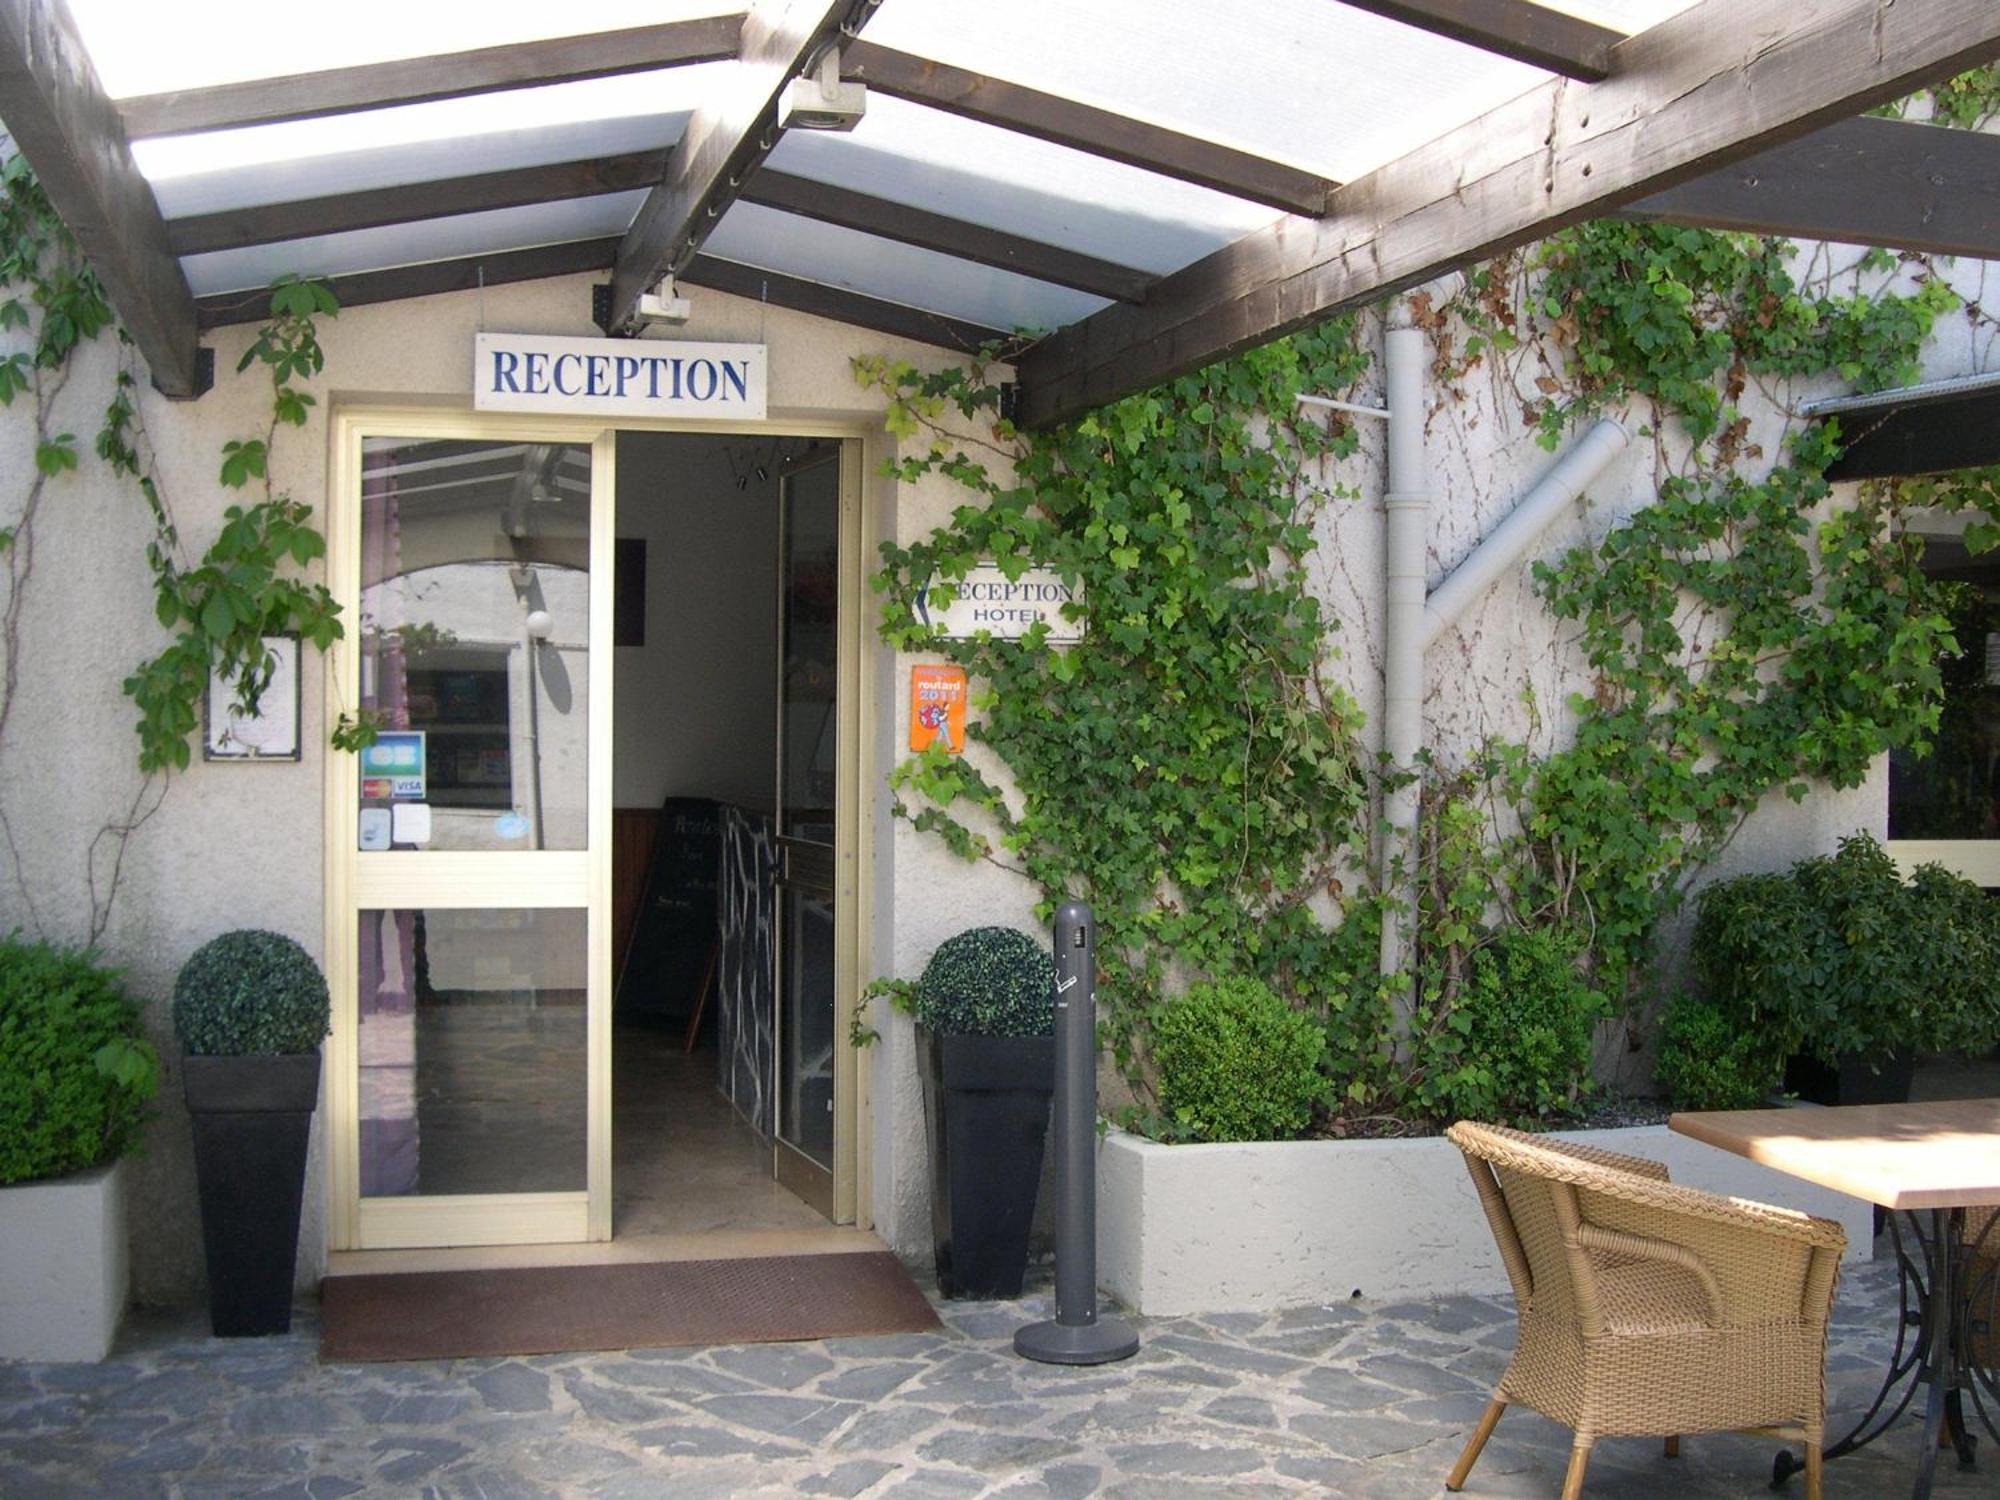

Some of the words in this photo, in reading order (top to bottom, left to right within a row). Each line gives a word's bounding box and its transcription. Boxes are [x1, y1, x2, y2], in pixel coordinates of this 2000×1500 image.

[490, 351, 750, 402] RECEPTION
[938, 582, 1074, 602] ECEPTION
[918, 680, 961, 691] routard
[397, 781, 422, 791] VISA
